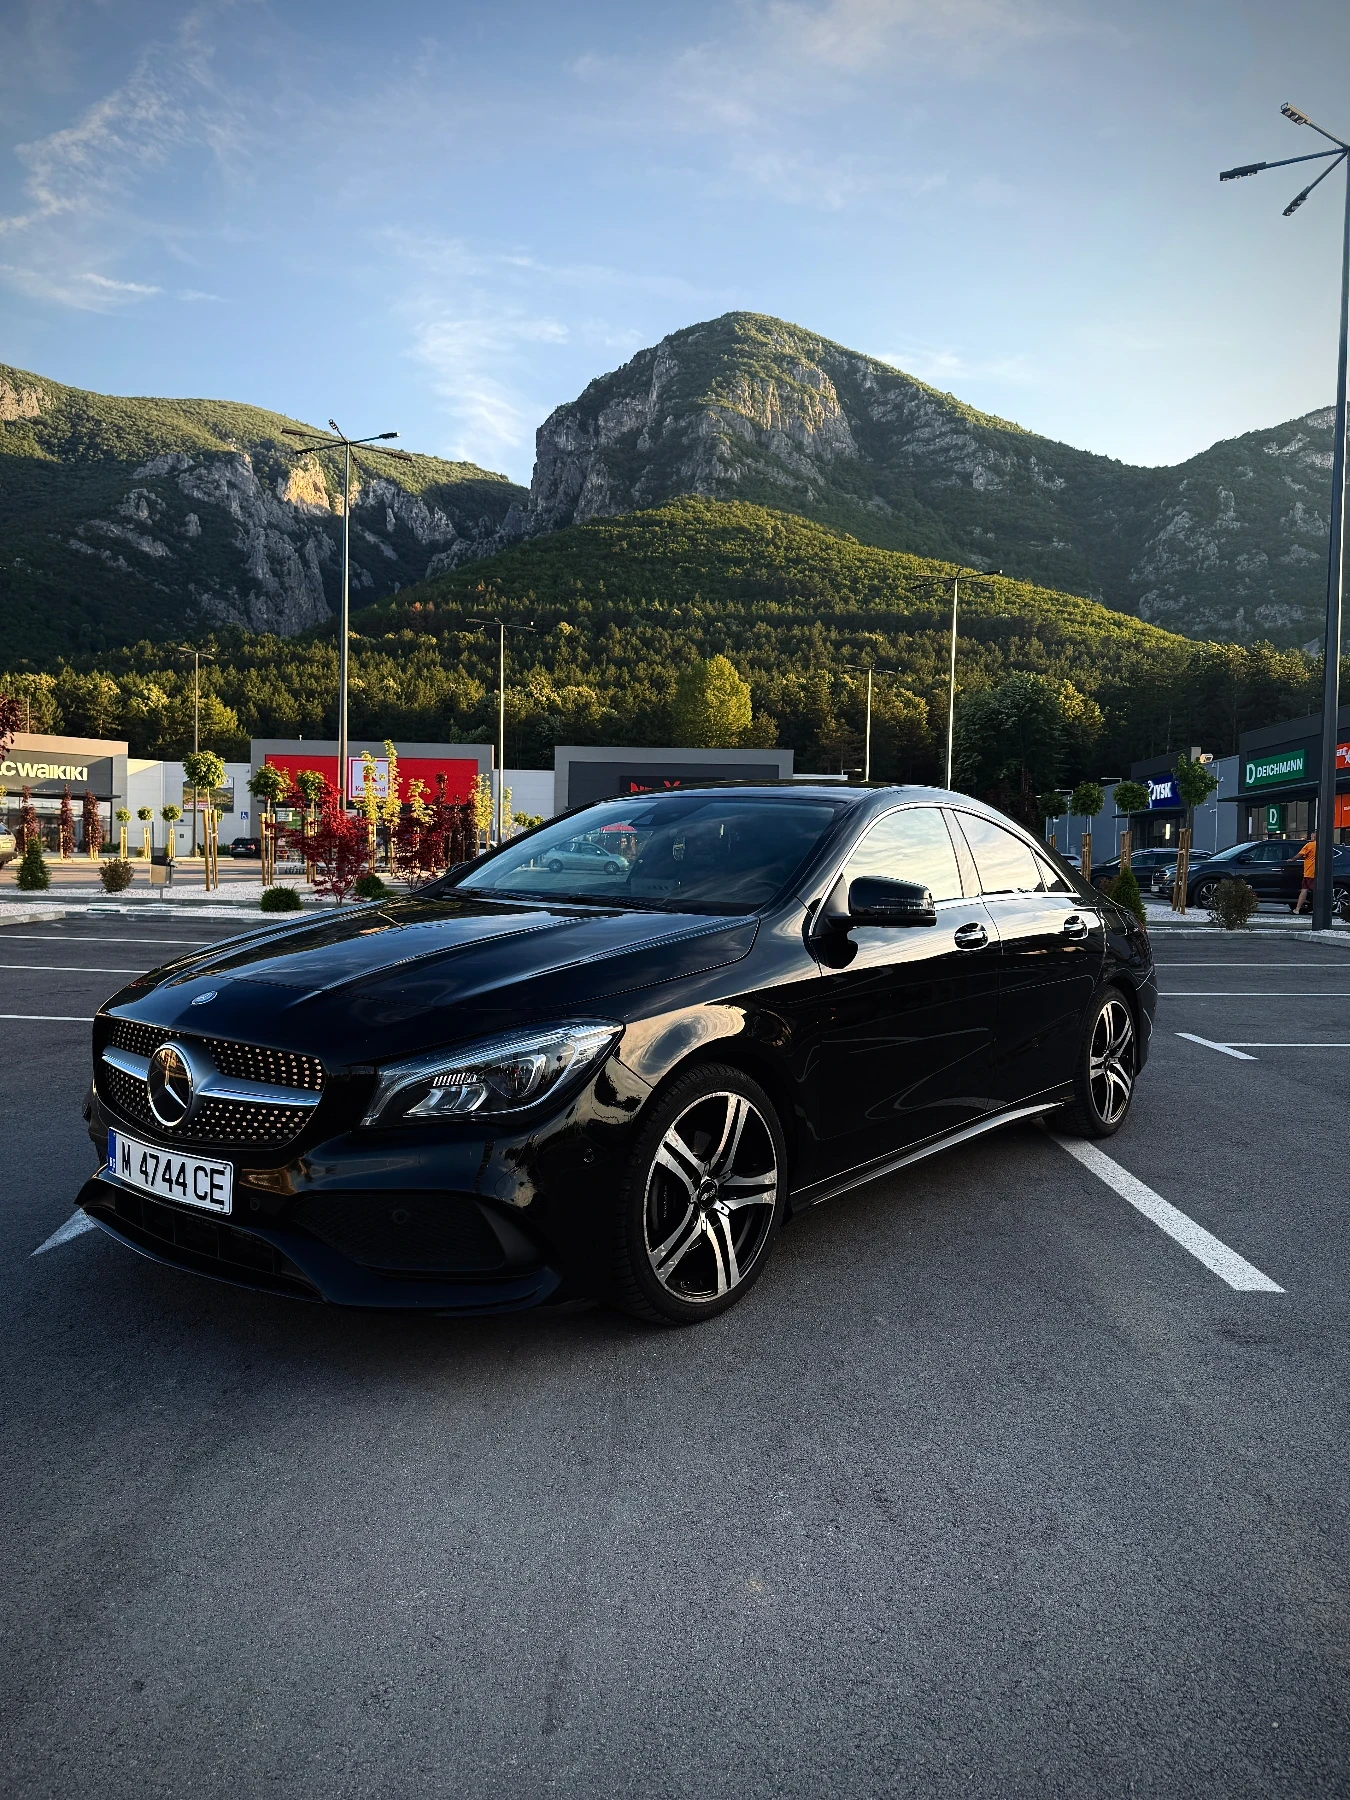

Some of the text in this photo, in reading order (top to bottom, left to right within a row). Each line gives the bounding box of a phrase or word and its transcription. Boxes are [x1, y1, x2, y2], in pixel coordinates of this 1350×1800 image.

[1257, 758, 1303, 778] DEICHMANN
[1151, 781, 1173, 801] JYSK
[121, 1140, 225, 1206] M 4744 CE
